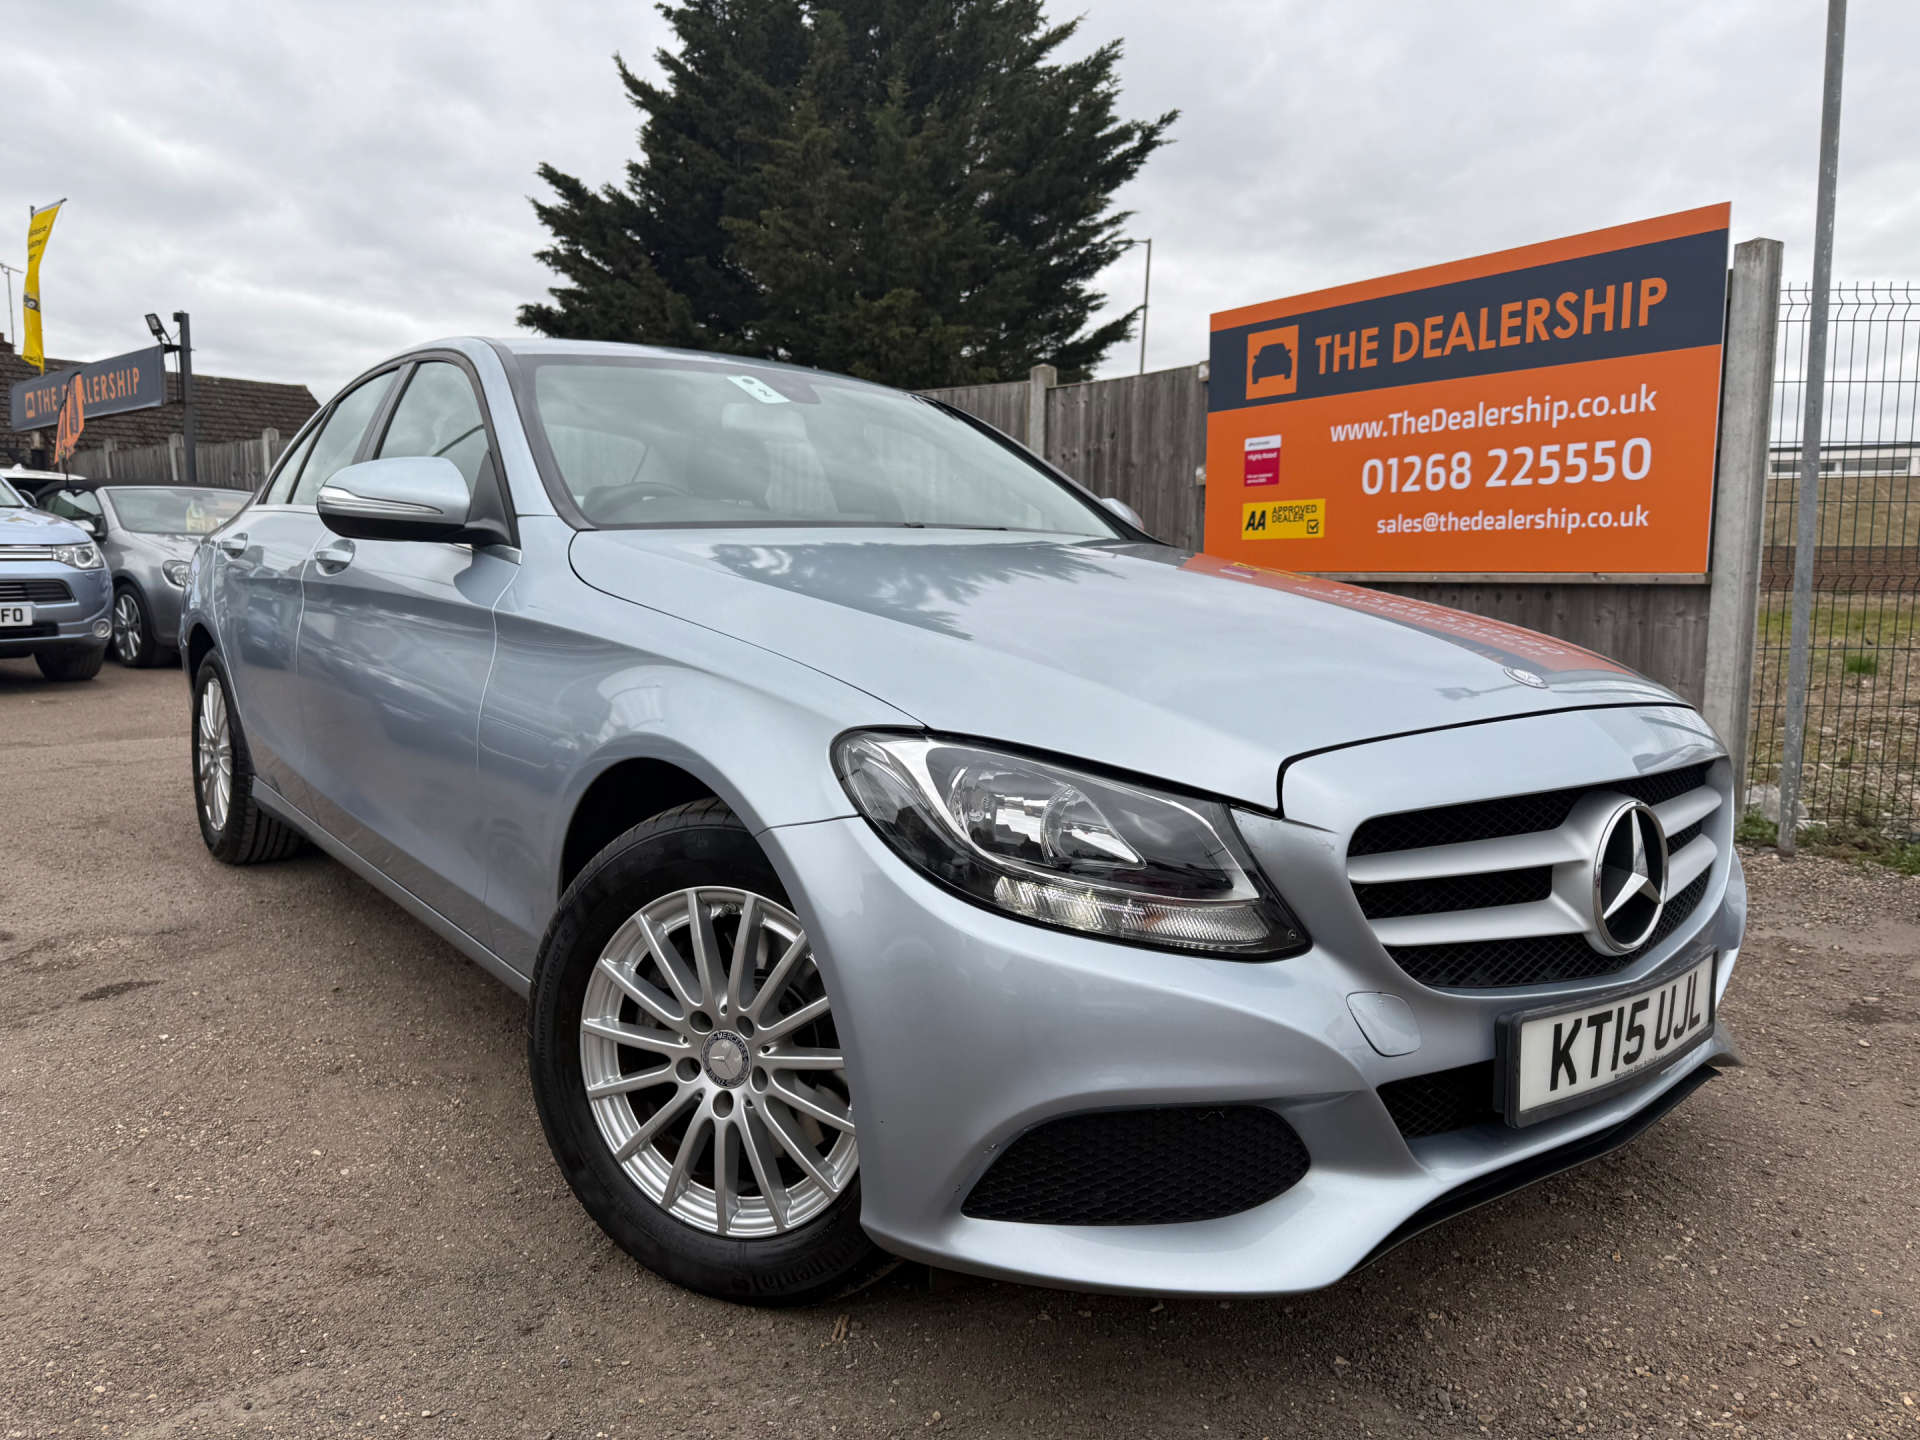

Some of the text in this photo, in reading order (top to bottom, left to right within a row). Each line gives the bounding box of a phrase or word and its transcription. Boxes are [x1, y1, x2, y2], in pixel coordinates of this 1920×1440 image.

[1315, 276, 1668, 375] THE DEALERSHIP
[37, 386, 58, 414] THE
[1330, 384, 1657, 443] www.TheDealership.co.uk
[1361, 437, 1652, 495] 01268 225550
[1245, 509, 1267, 531] AA
[1272, 504, 1317, 514] APPROVED
[1272, 512, 1305, 523] DEALER
[1376, 505, 1649, 535] sales@thedealership.co.uk
[1550, 970, 1701, 1092] KT15 UJL
